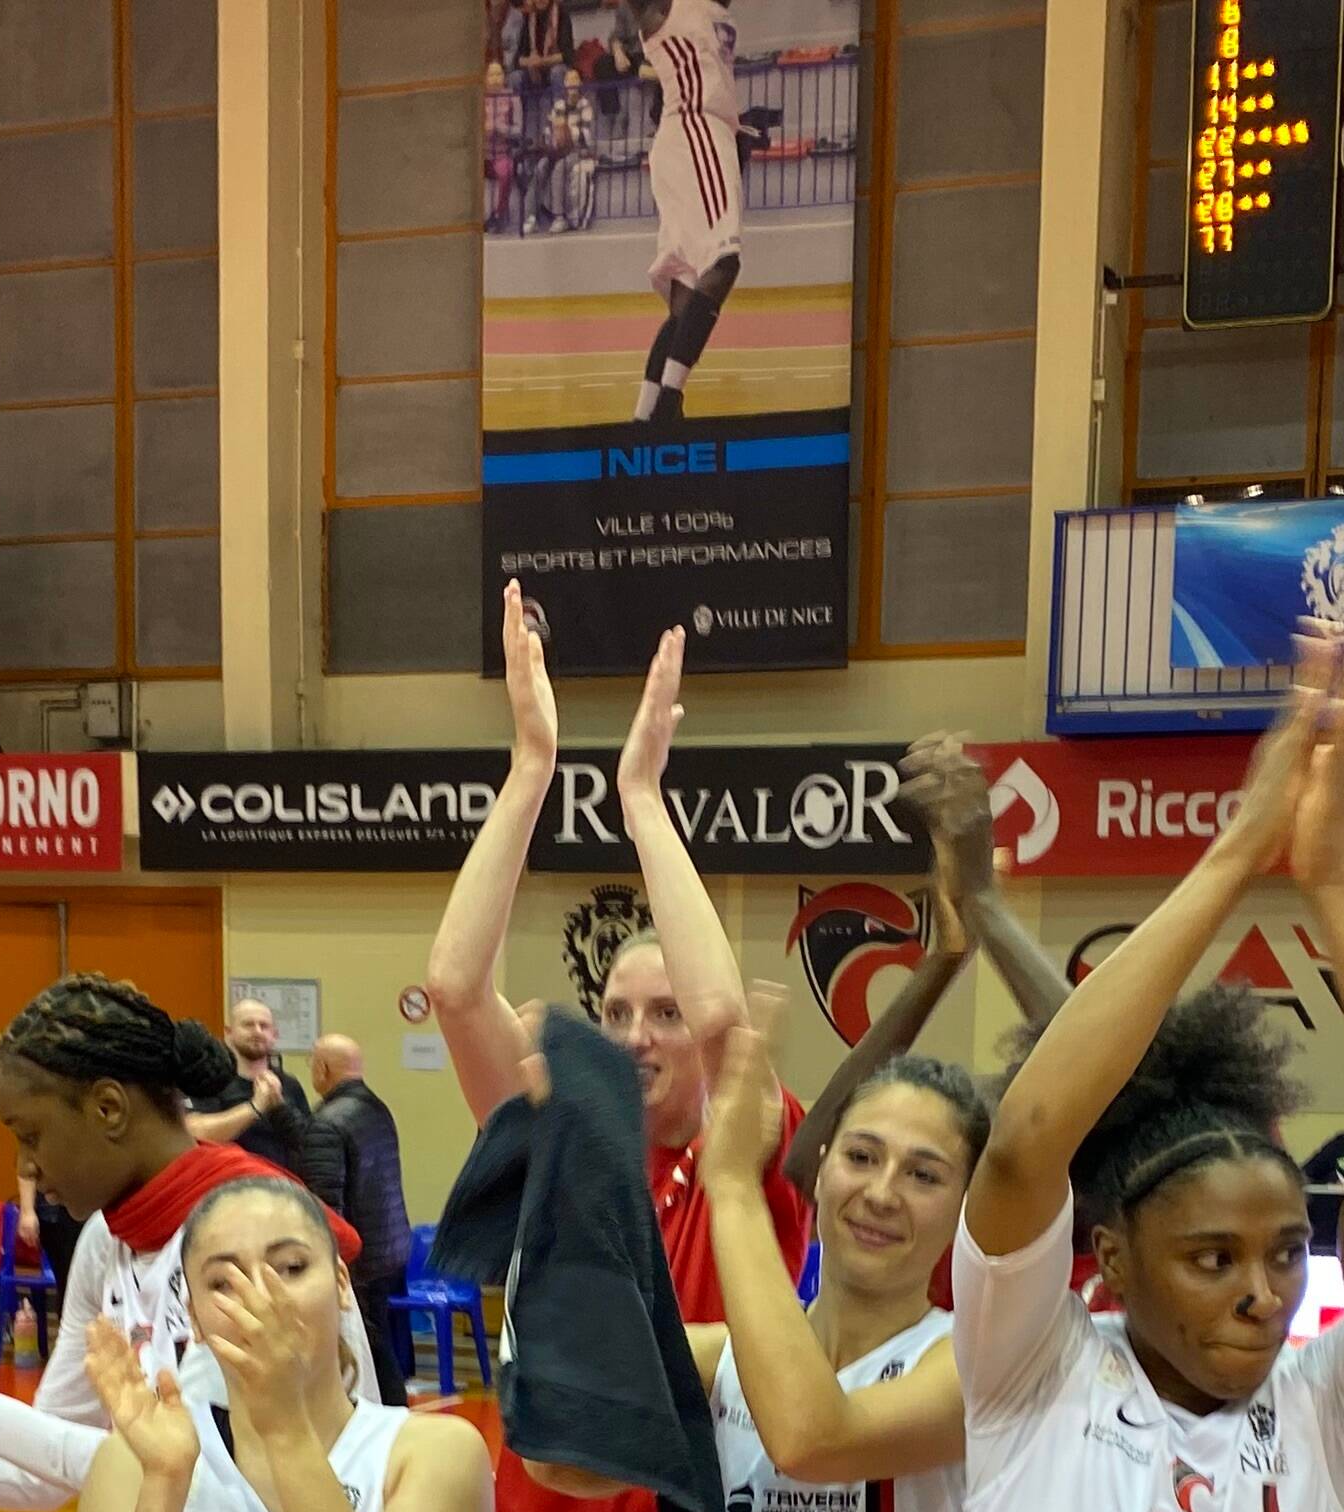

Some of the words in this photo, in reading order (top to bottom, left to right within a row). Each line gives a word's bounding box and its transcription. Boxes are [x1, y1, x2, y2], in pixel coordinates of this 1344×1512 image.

[608, 442, 717, 478] NICE
[596, 512, 655, 538] VILLE
[662, 509, 734, 533] 100%
[500, 550, 595, 575] SPORTS
[599, 549, 628, 571] ET
[631, 536, 832, 567] PERFORMANCES
[715, 606, 757, 630] VILLE
[764, 606, 789, 627] DE
[792, 605, 834, 626] NICE
[200, 781, 499, 825] COLISLAND
[554, 760, 914, 850] RVALOR
